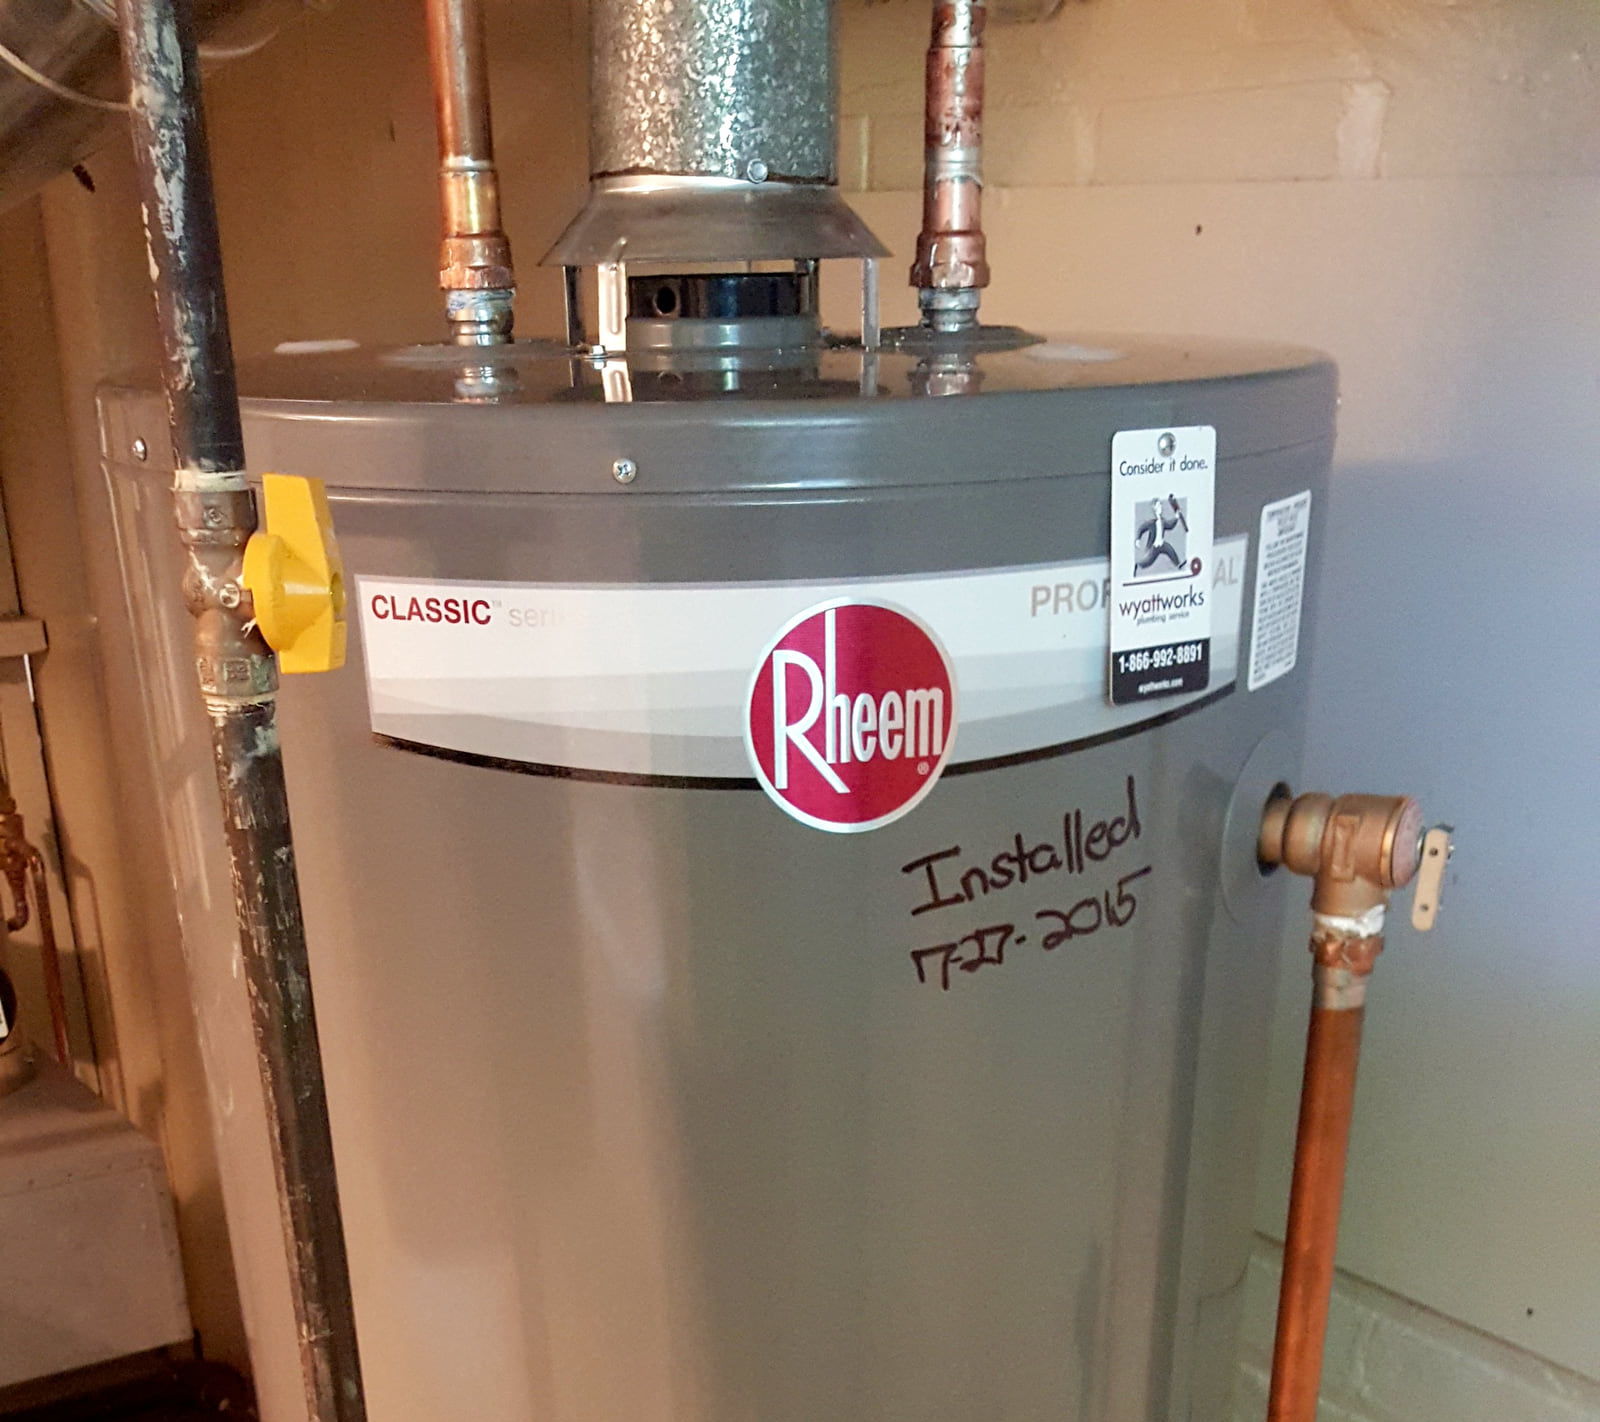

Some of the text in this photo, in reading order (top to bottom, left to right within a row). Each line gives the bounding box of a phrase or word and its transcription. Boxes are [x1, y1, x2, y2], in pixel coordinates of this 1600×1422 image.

[1119, 456, 1208, 477] Consider it done.
[1119, 585, 1205, 619] wyattworks
[1118, 643, 1203, 674] 1-866-992-8891
[771, 608, 945, 794] Rheem
[902, 774, 1141, 916] Installed
